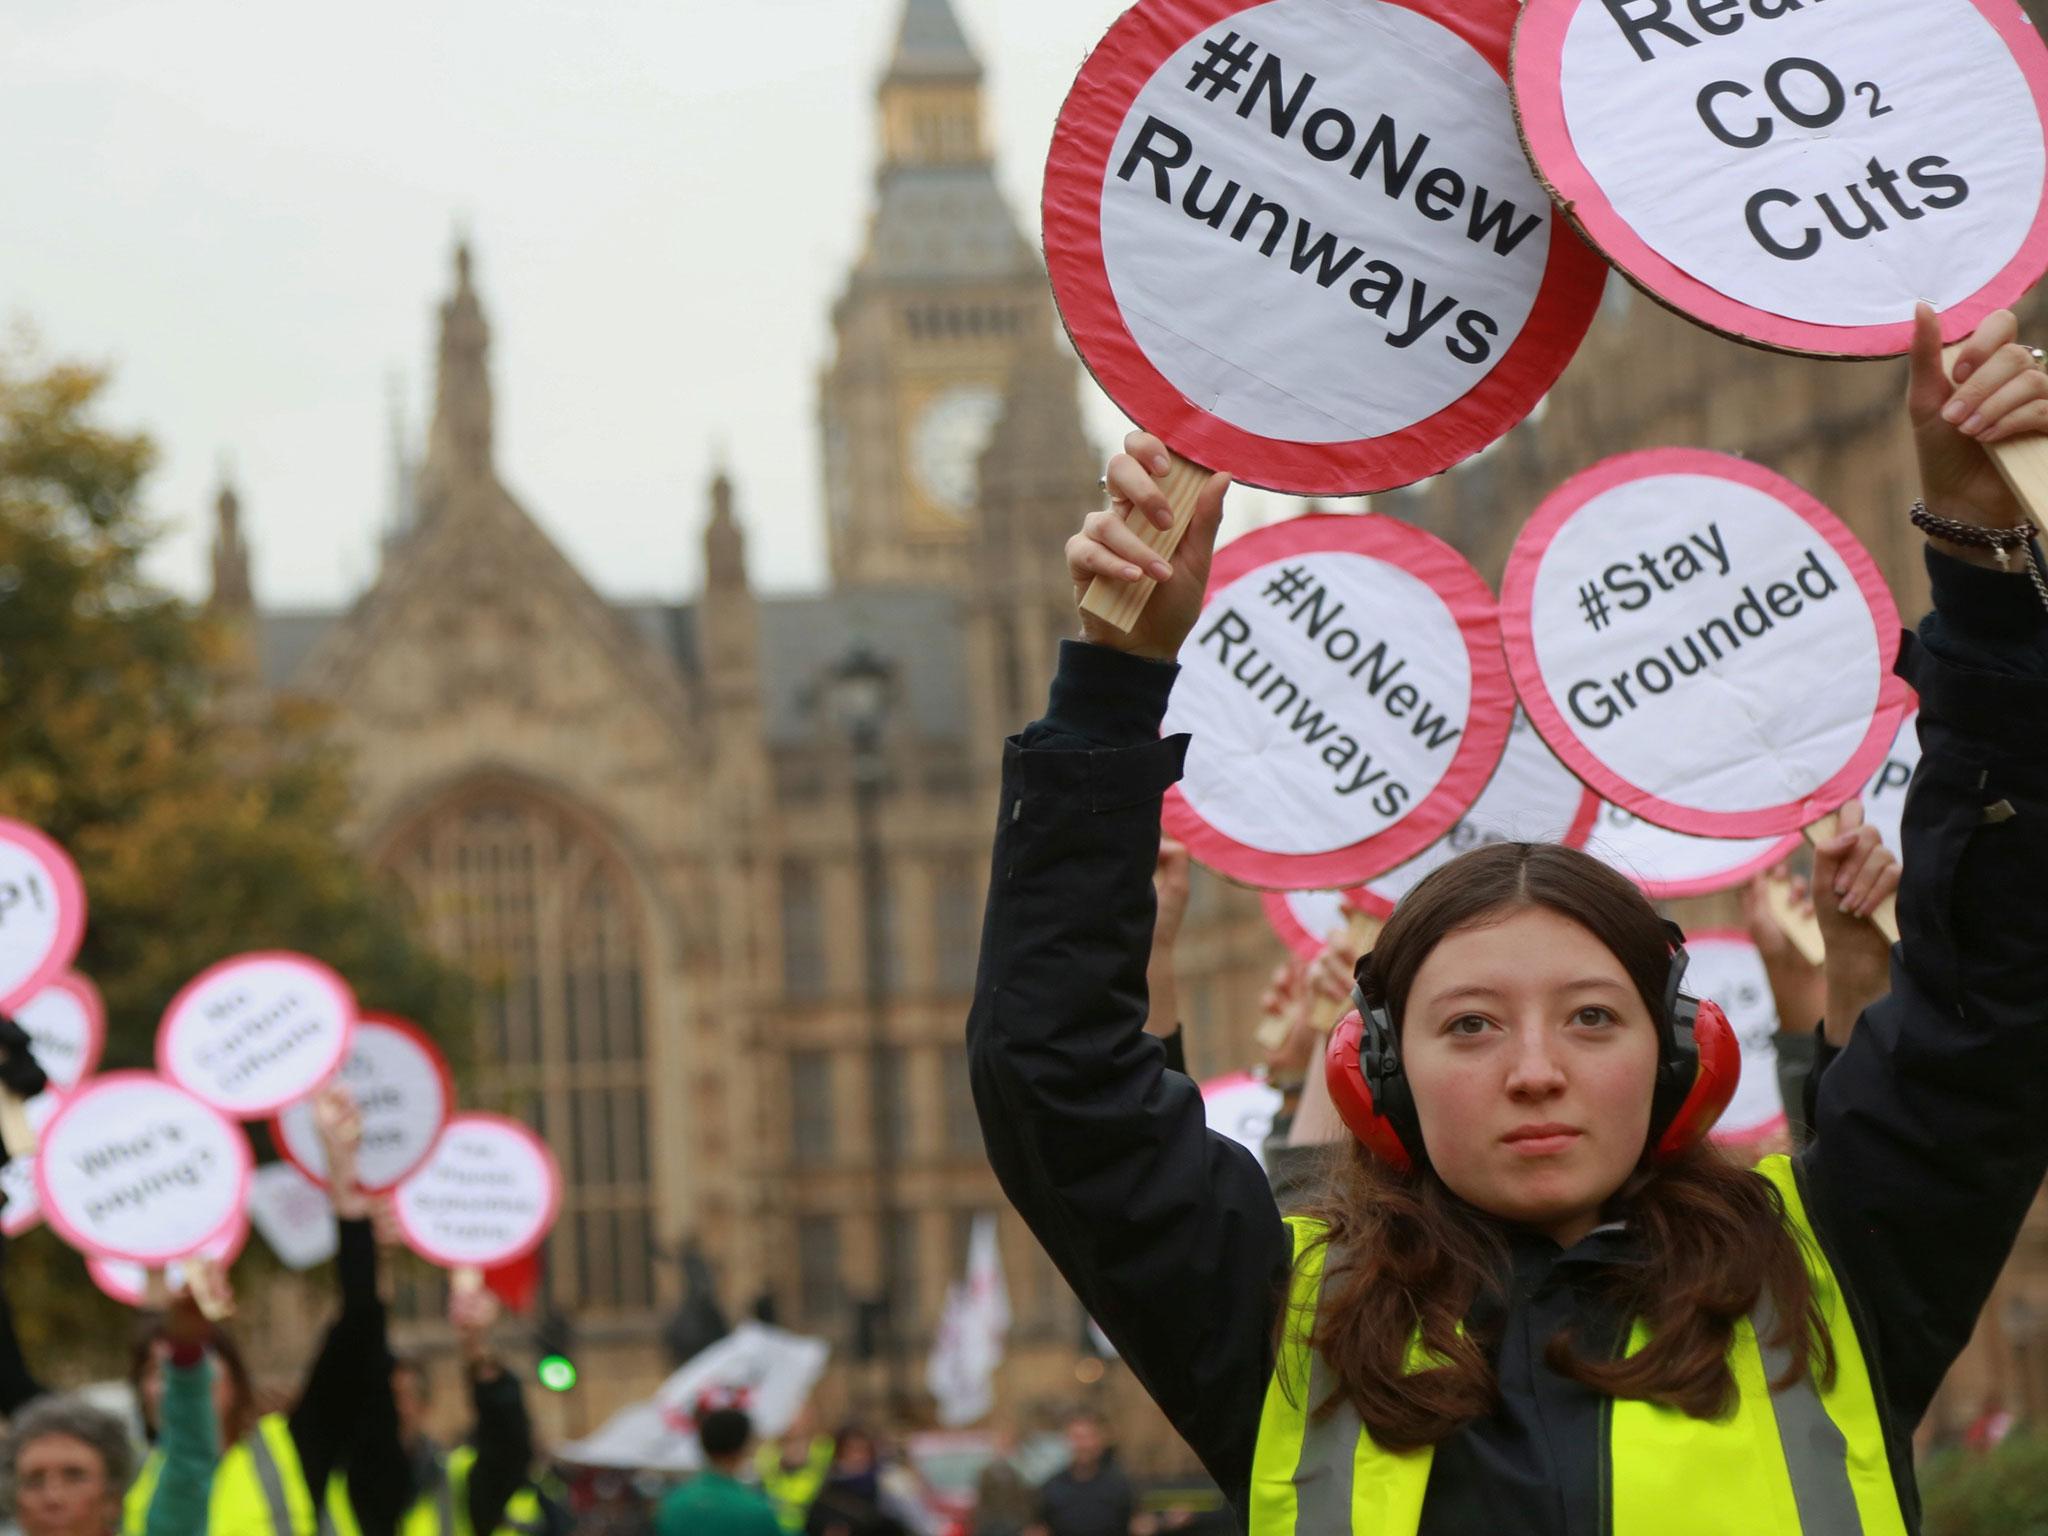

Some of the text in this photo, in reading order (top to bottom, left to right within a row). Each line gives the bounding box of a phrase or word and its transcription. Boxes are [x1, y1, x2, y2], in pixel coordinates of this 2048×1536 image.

[1605, 0, 1826, 62] Re
[1185, 31, 1542, 257] #NoNew
[1744, 155, 1970, 261] Cuts
[1116, 115, 1499, 364] Runways
[1261, 565, 1462, 752] #NoNew
[1567, 550, 1839, 730] Grounded
[1578, 522, 1731, 632] #Stay
[1200, 608, 1411, 819] Runways
